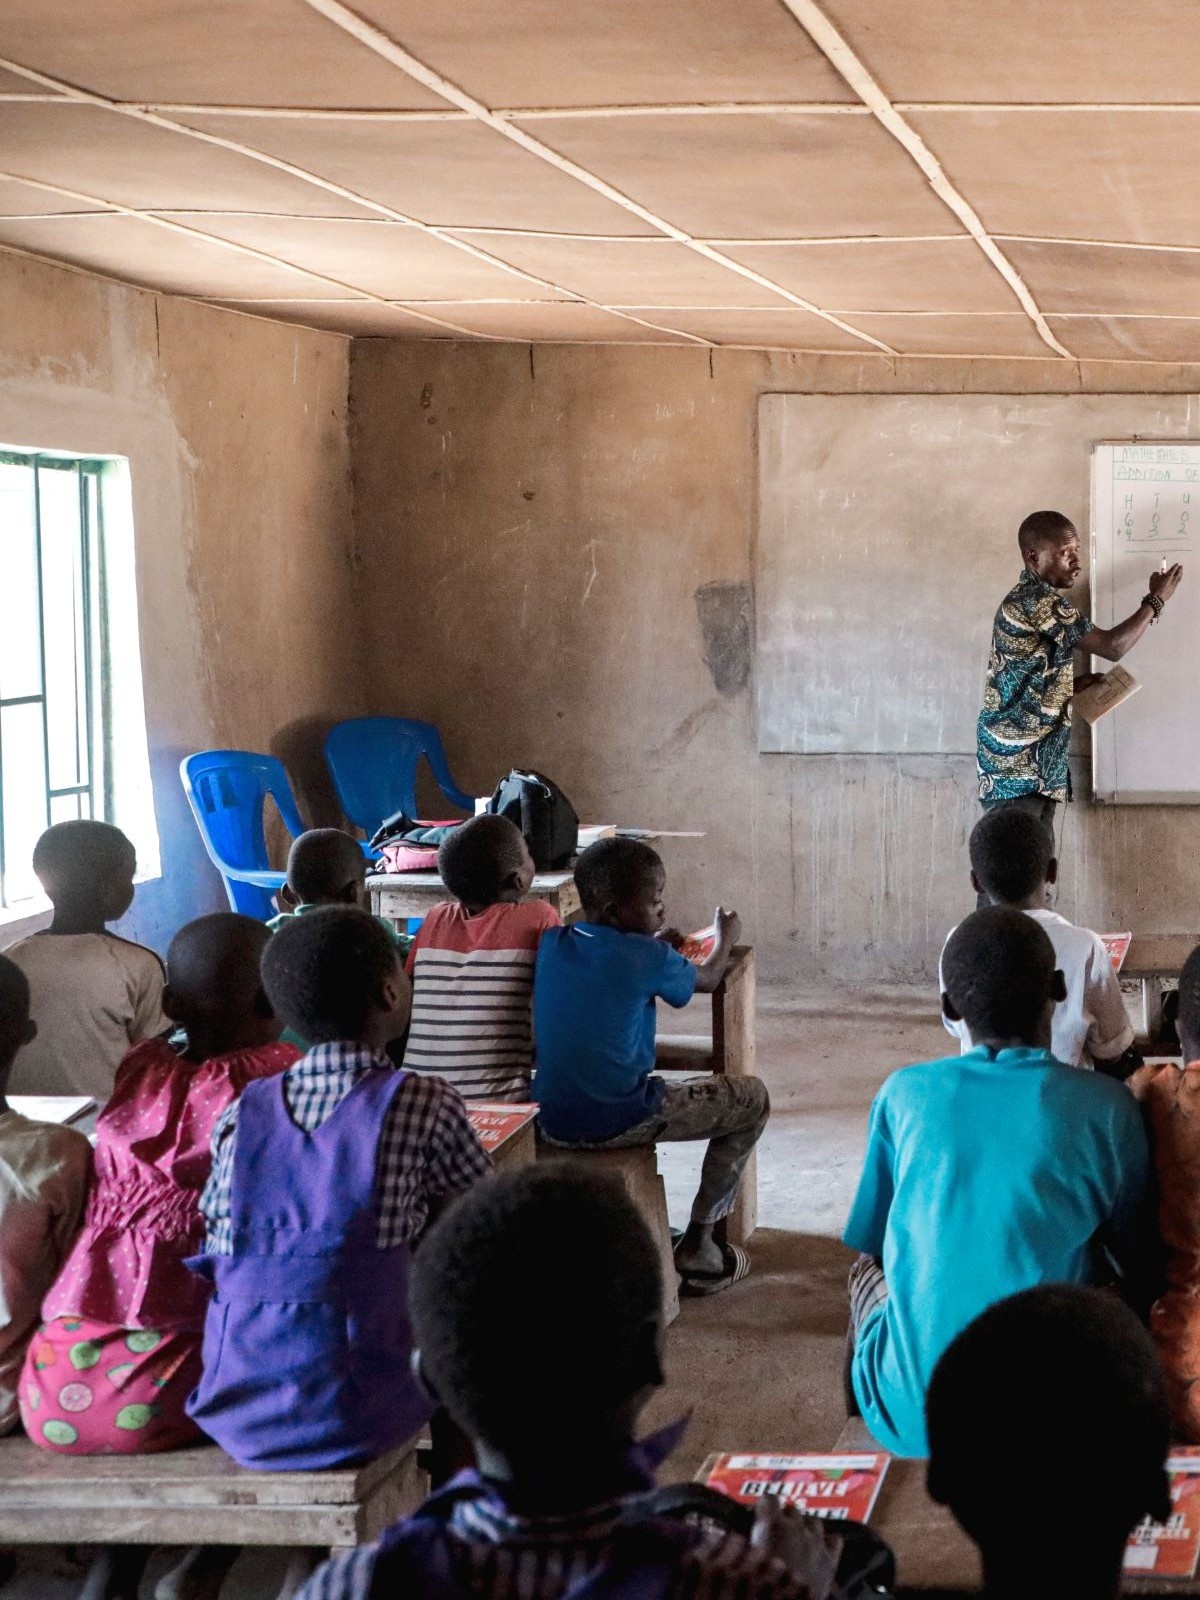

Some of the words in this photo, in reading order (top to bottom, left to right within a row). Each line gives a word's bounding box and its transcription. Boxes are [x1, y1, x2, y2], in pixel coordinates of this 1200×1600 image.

[1117, 466, 1171, 480] ADDITION
[1185, 468, 1199, 480] OF
[1124, 492, 1133, 510] H
[1182, 492, 1190, 504] U
[1124, 512, 1134, 527] 6
[1151, 512, 1160, 525] 0
[1180, 510, 1189, 521] 0
[1125, 528, 1132, 539] 4
[1148, 525, 1160, 538] 3
[1177, 522, 1188, 534] 2
